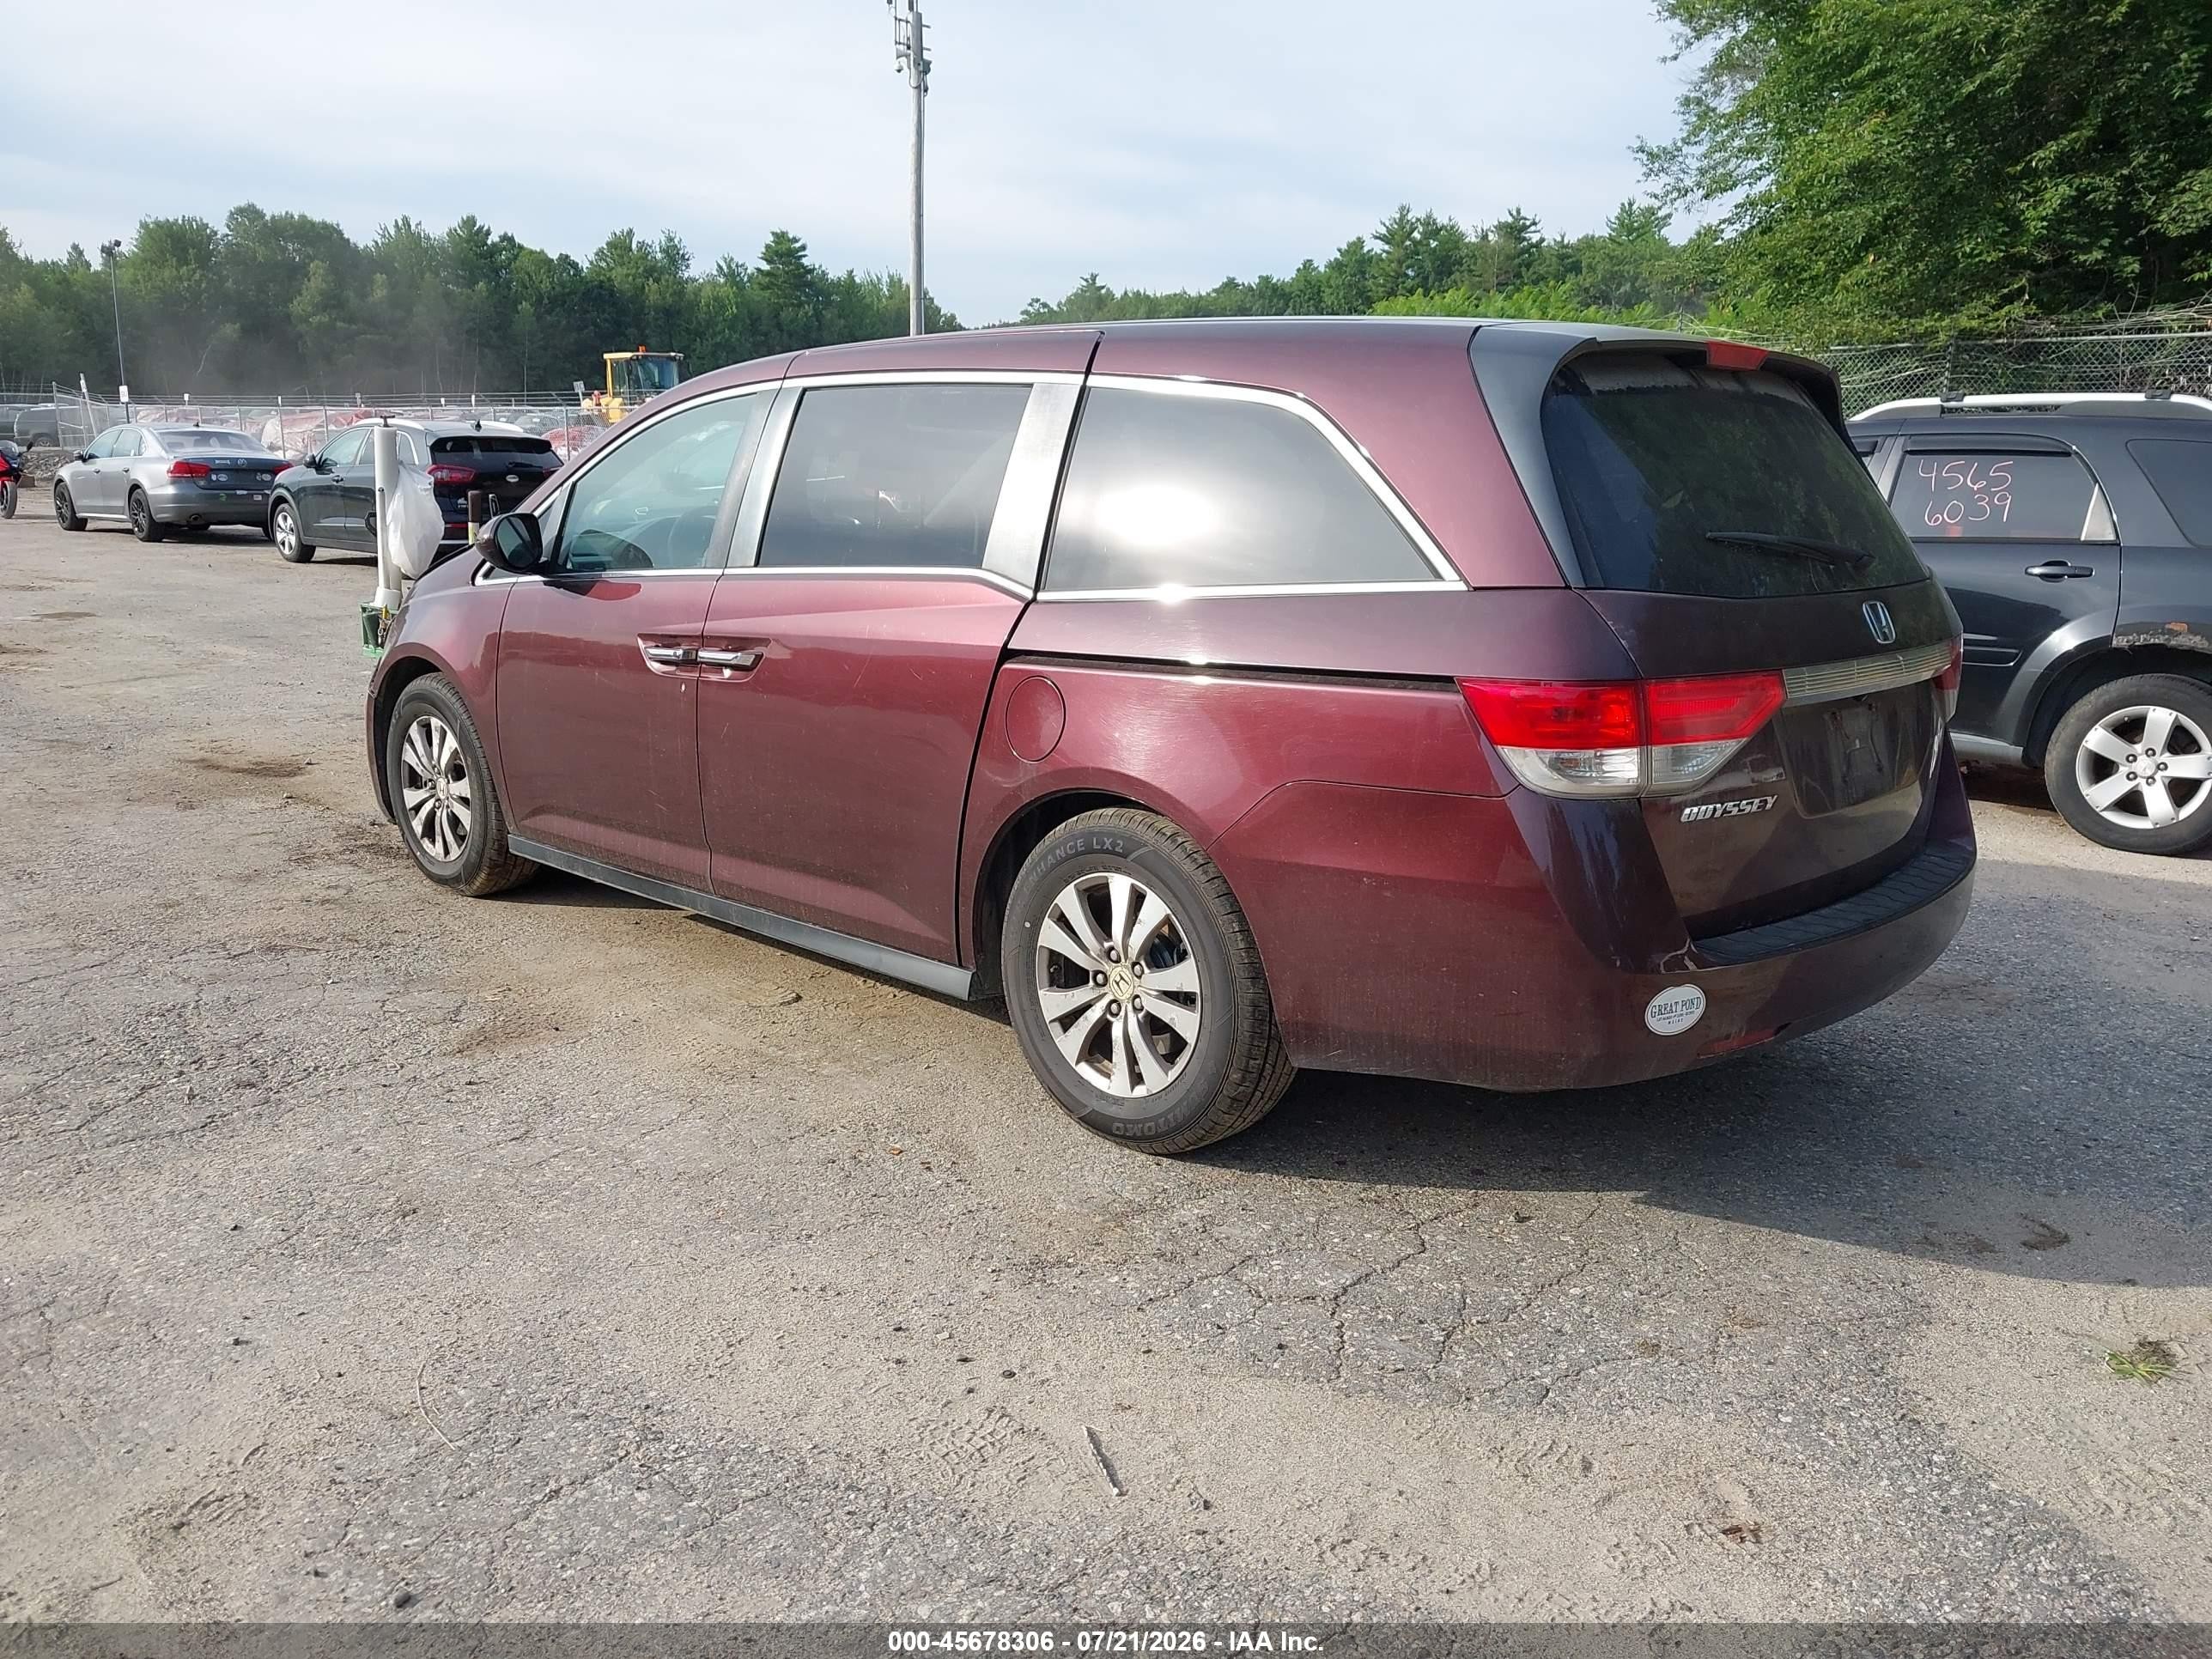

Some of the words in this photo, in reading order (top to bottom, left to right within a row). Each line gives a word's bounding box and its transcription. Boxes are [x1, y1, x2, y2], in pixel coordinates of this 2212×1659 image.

[1918, 459, 2014, 491] 4565
[1924, 491, 2012, 526] 6039
[1680, 794, 1778, 823] ODYSSEY
[1092, 837, 1124, 854] LX2
[1650, 1000, 1680, 1018] GREAT
[1680, 996, 1702, 1012] POND
